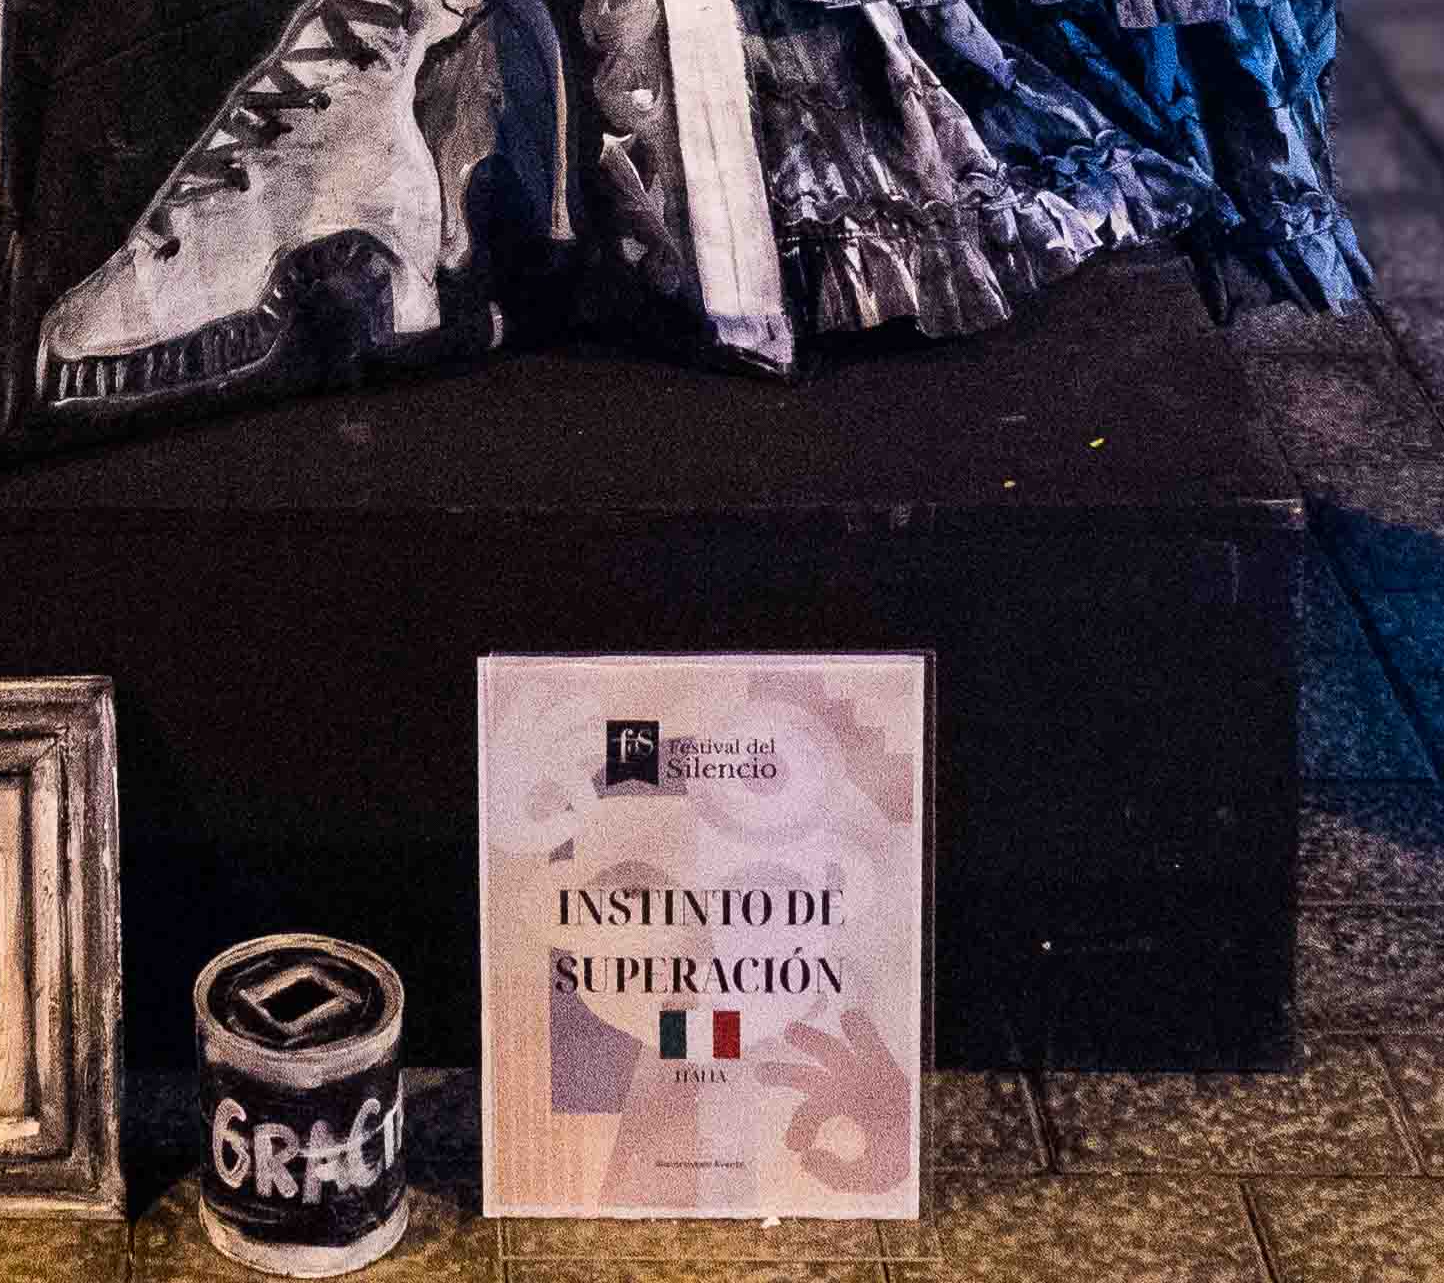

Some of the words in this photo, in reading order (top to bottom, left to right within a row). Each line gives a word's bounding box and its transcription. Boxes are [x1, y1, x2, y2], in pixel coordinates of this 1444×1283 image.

[670, 738, 740, 755] Festival
[746, 738, 775, 755] del
[666, 757, 778, 779] Silencio
[560, 889, 773, 926] INSTINTO
[786, 889, 845, 926] DE
[555, 947, 843, 994] SUPERACIÓN
